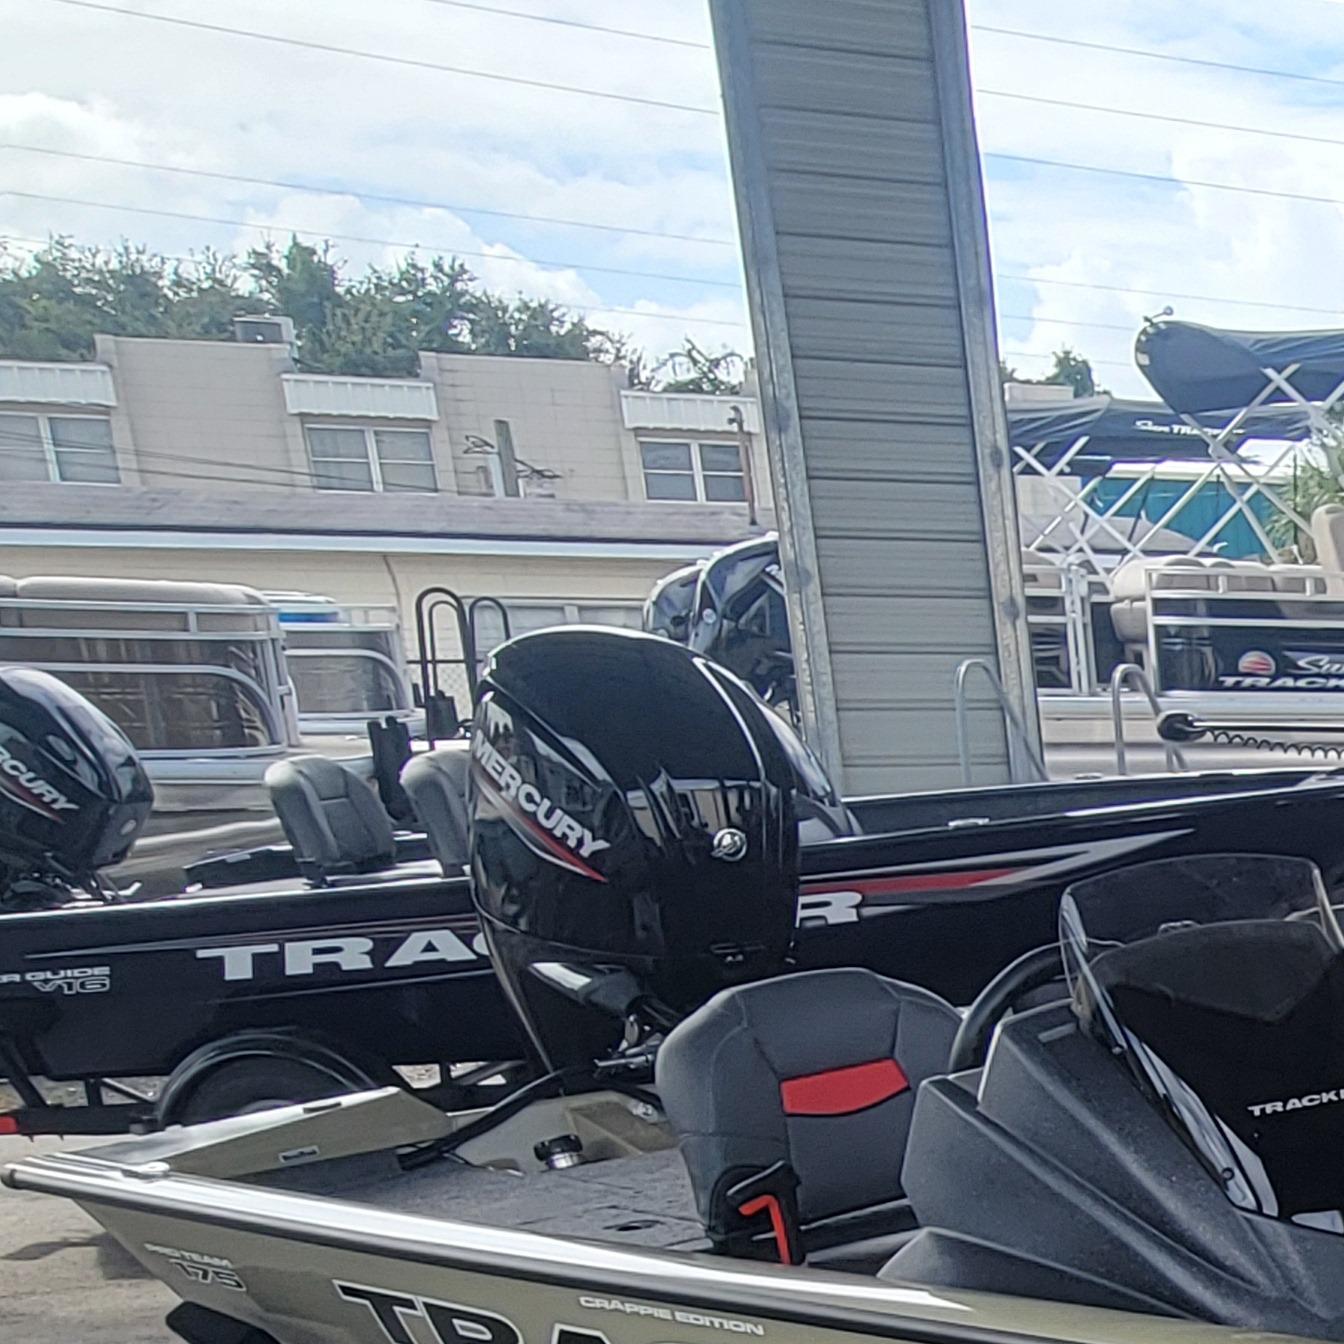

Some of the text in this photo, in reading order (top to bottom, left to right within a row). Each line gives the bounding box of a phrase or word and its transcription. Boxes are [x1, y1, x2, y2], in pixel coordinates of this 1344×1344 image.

[473, 728, 612, 858] MERCURY
[25, 966, 111, 981] GUIDE
[31, 976, 111, 995] V16
[169, 1258, 247, 1292] 175
[578, 1296, 766, 1337] CRAPPIE EDITION
